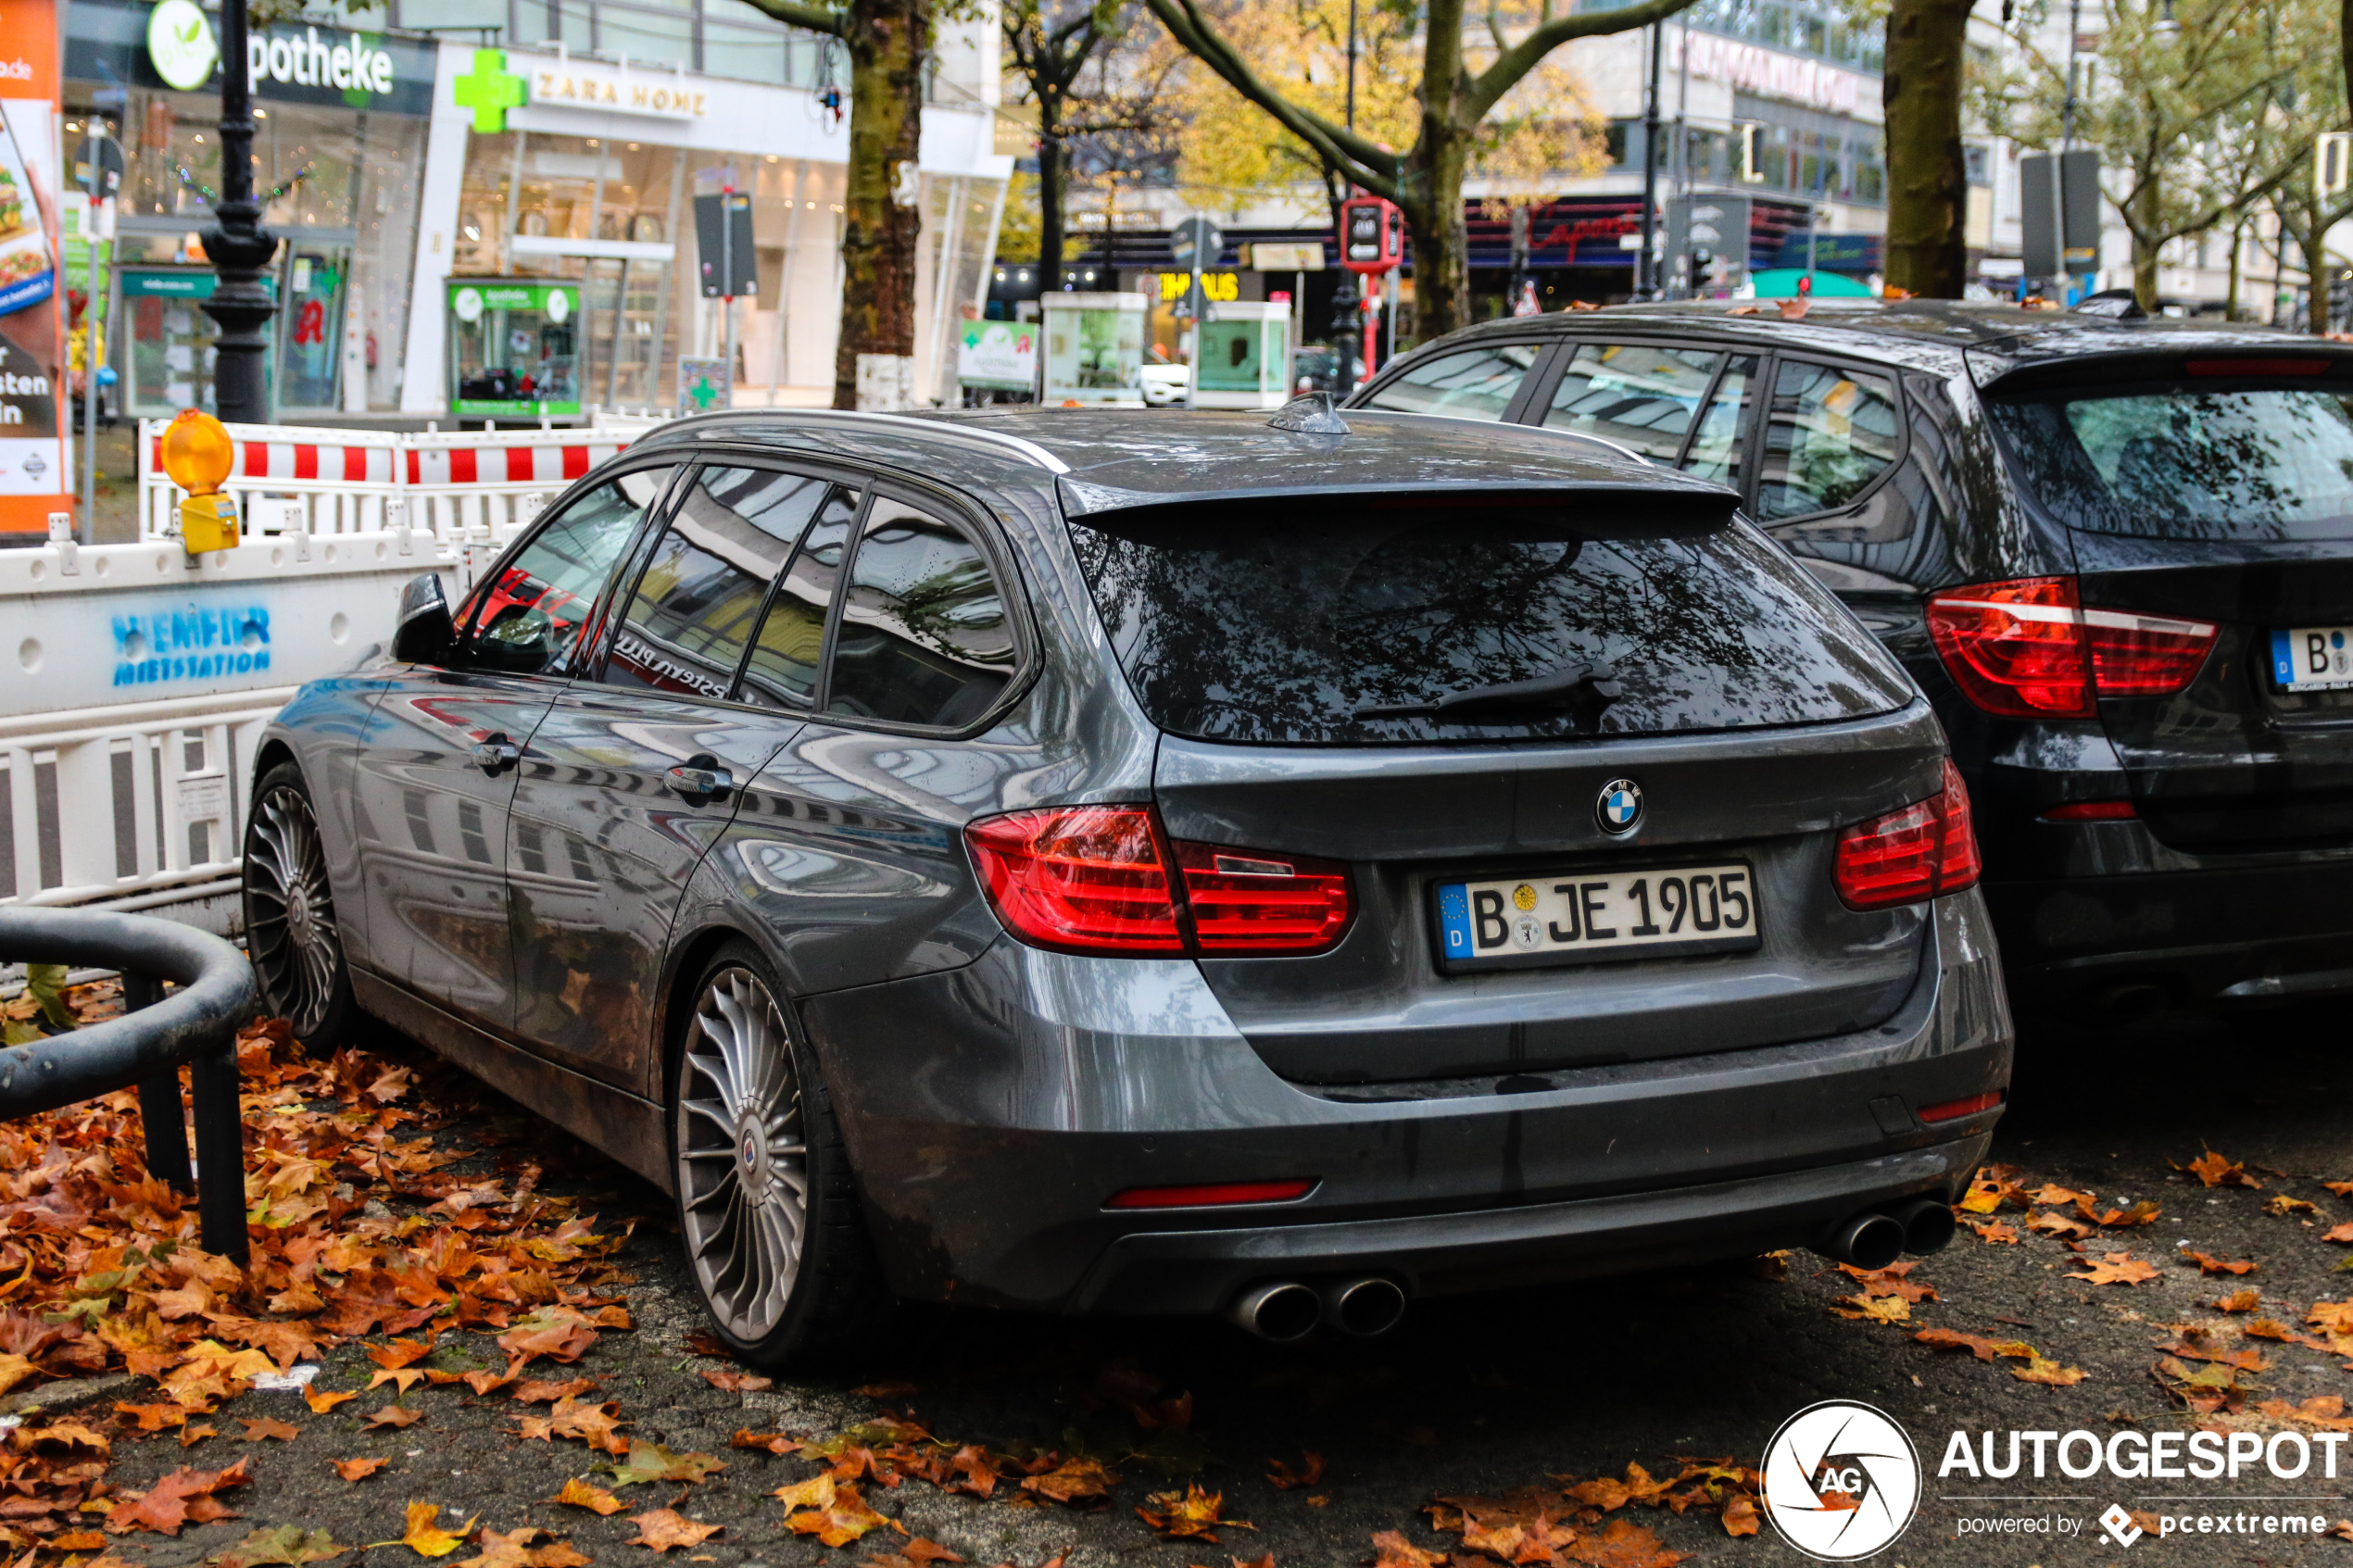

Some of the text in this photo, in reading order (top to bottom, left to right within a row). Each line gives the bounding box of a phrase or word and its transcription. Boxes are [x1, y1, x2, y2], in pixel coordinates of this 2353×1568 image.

[217, 26, 394, 94] potheke
[539, 73, 706, 116] ZARA HOME
[113, 652, 270, 687] MIETSTATION
[2307, 633, 2330, 674] B
[1603, 781, 1641, 799] BMW
[1472, 889, 1509, 949] B
[1548, 882, 1617, 943] JE
[1628, 872, 1750, 936] 1905
[1450, 930, 1463, 947] D
